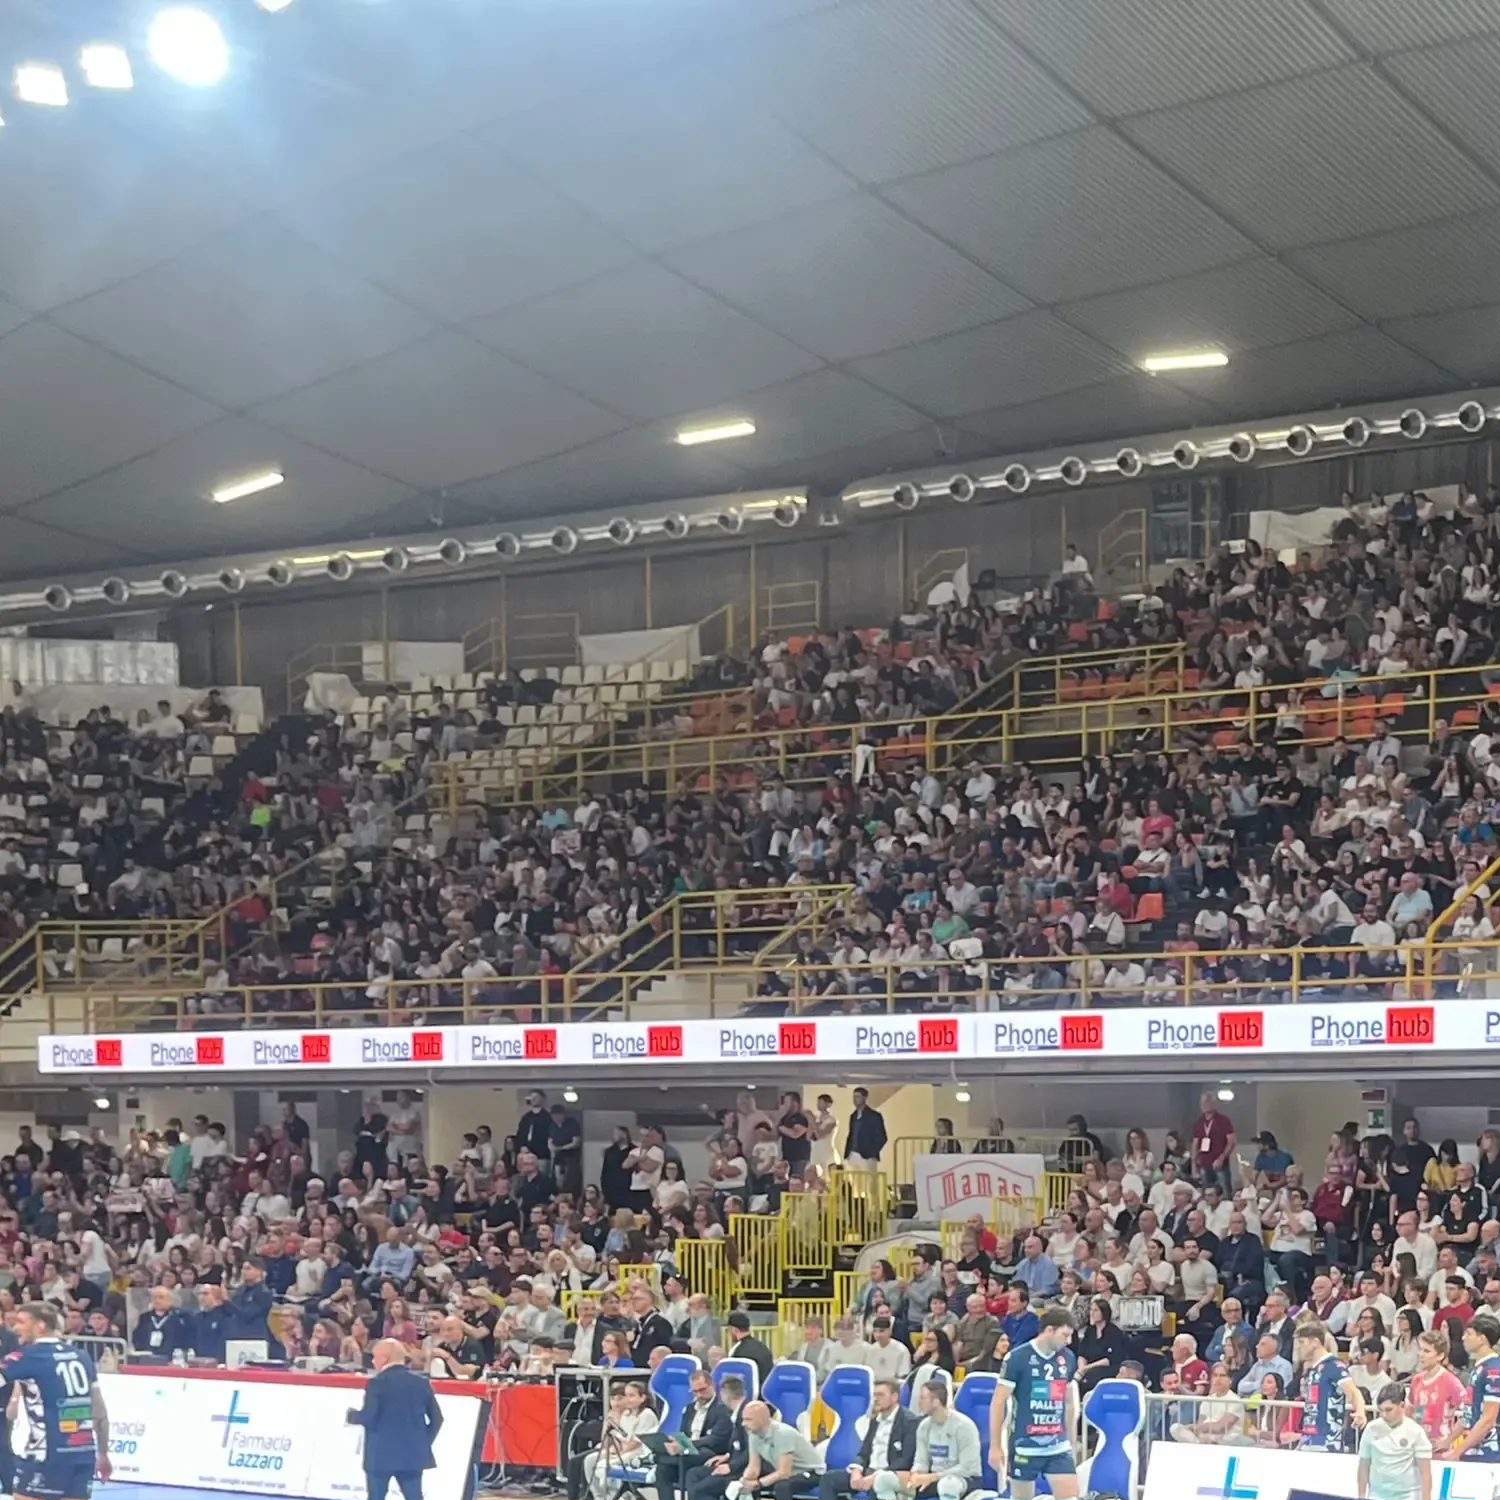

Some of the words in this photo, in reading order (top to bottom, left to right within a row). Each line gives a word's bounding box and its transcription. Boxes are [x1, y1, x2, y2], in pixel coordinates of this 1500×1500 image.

[856, 1027, 917, 1047] Phone
[923, 1026, 955, 1047] hub
[995, 1023, 1059, 1044] Phone
[1065, 1022, 1100, 1044] hub
[1148, 1020, 1216, 1041] Phone
[1222, 1018, 1259, 1041] hub
[1311, 1016, 1384, 1038] Phone
[1390, 1015, 1430, 1038] hub
[254, 1041, 300, 1058] Phone
[304, 1041, 327, 1058] hub
[362, 1038, 411, 1056] Phone
[415, 1038, 439, 1056] hub
[471, 1035, 523, 1054] Phone
[527, 1035, 554, 1054] hub
[592, 1033, 647, 1052] Phone
[651, 1033, 680, 1052] hub
[720, 1030, 778, 1049] Phone
[782, 1030, 813, 1050] hub
[52, 1045, 95, 1062] Phone
[99, 1046, 120, 1062] hub
[151, 1043, 195, 1060] Phone
[199, 1043, 221, 1060] hub
[56, 1360, 90, 1396] 10
[1043, 1363, 1055, 1380] 2
[232, 1431, 292, 1452] Farmacia
[228, 1449, 284, 1470] Lazzaro
